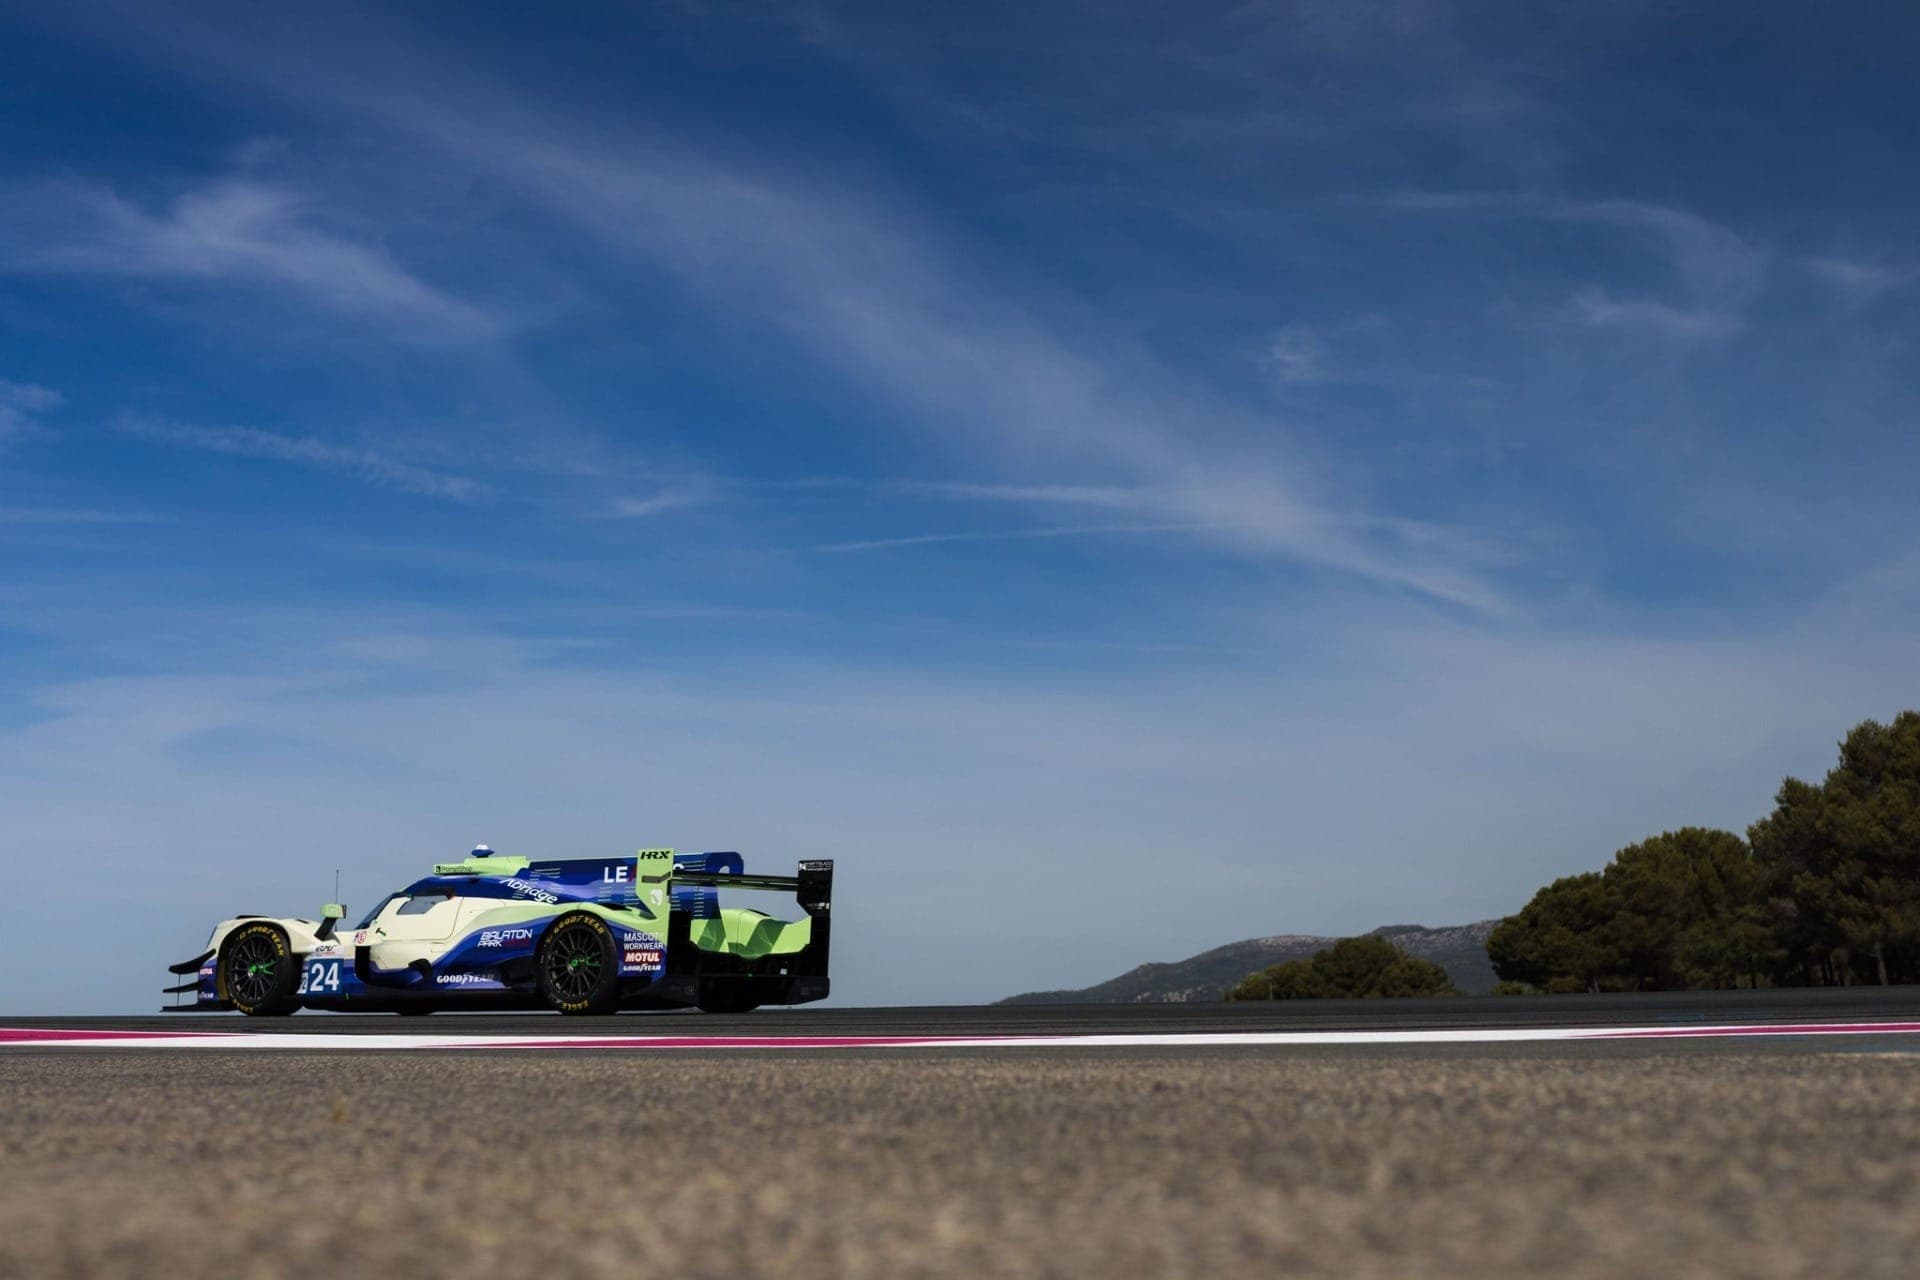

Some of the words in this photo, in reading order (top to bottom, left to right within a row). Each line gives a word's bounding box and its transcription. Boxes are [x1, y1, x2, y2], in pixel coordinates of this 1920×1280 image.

[640, 851, 670, 860] HRX
[500, 879, 558, 904] Abridge
[480, 929, 533, 940] BALATON
[477, 940, 502, 948] PARK
[624, 942, 663, 950] WORKWEAR
[625, 952, 660, 962] MOTUL
[623, 963, 661, 972] GOODYEAR
[310, 963, 340, 991] 24
